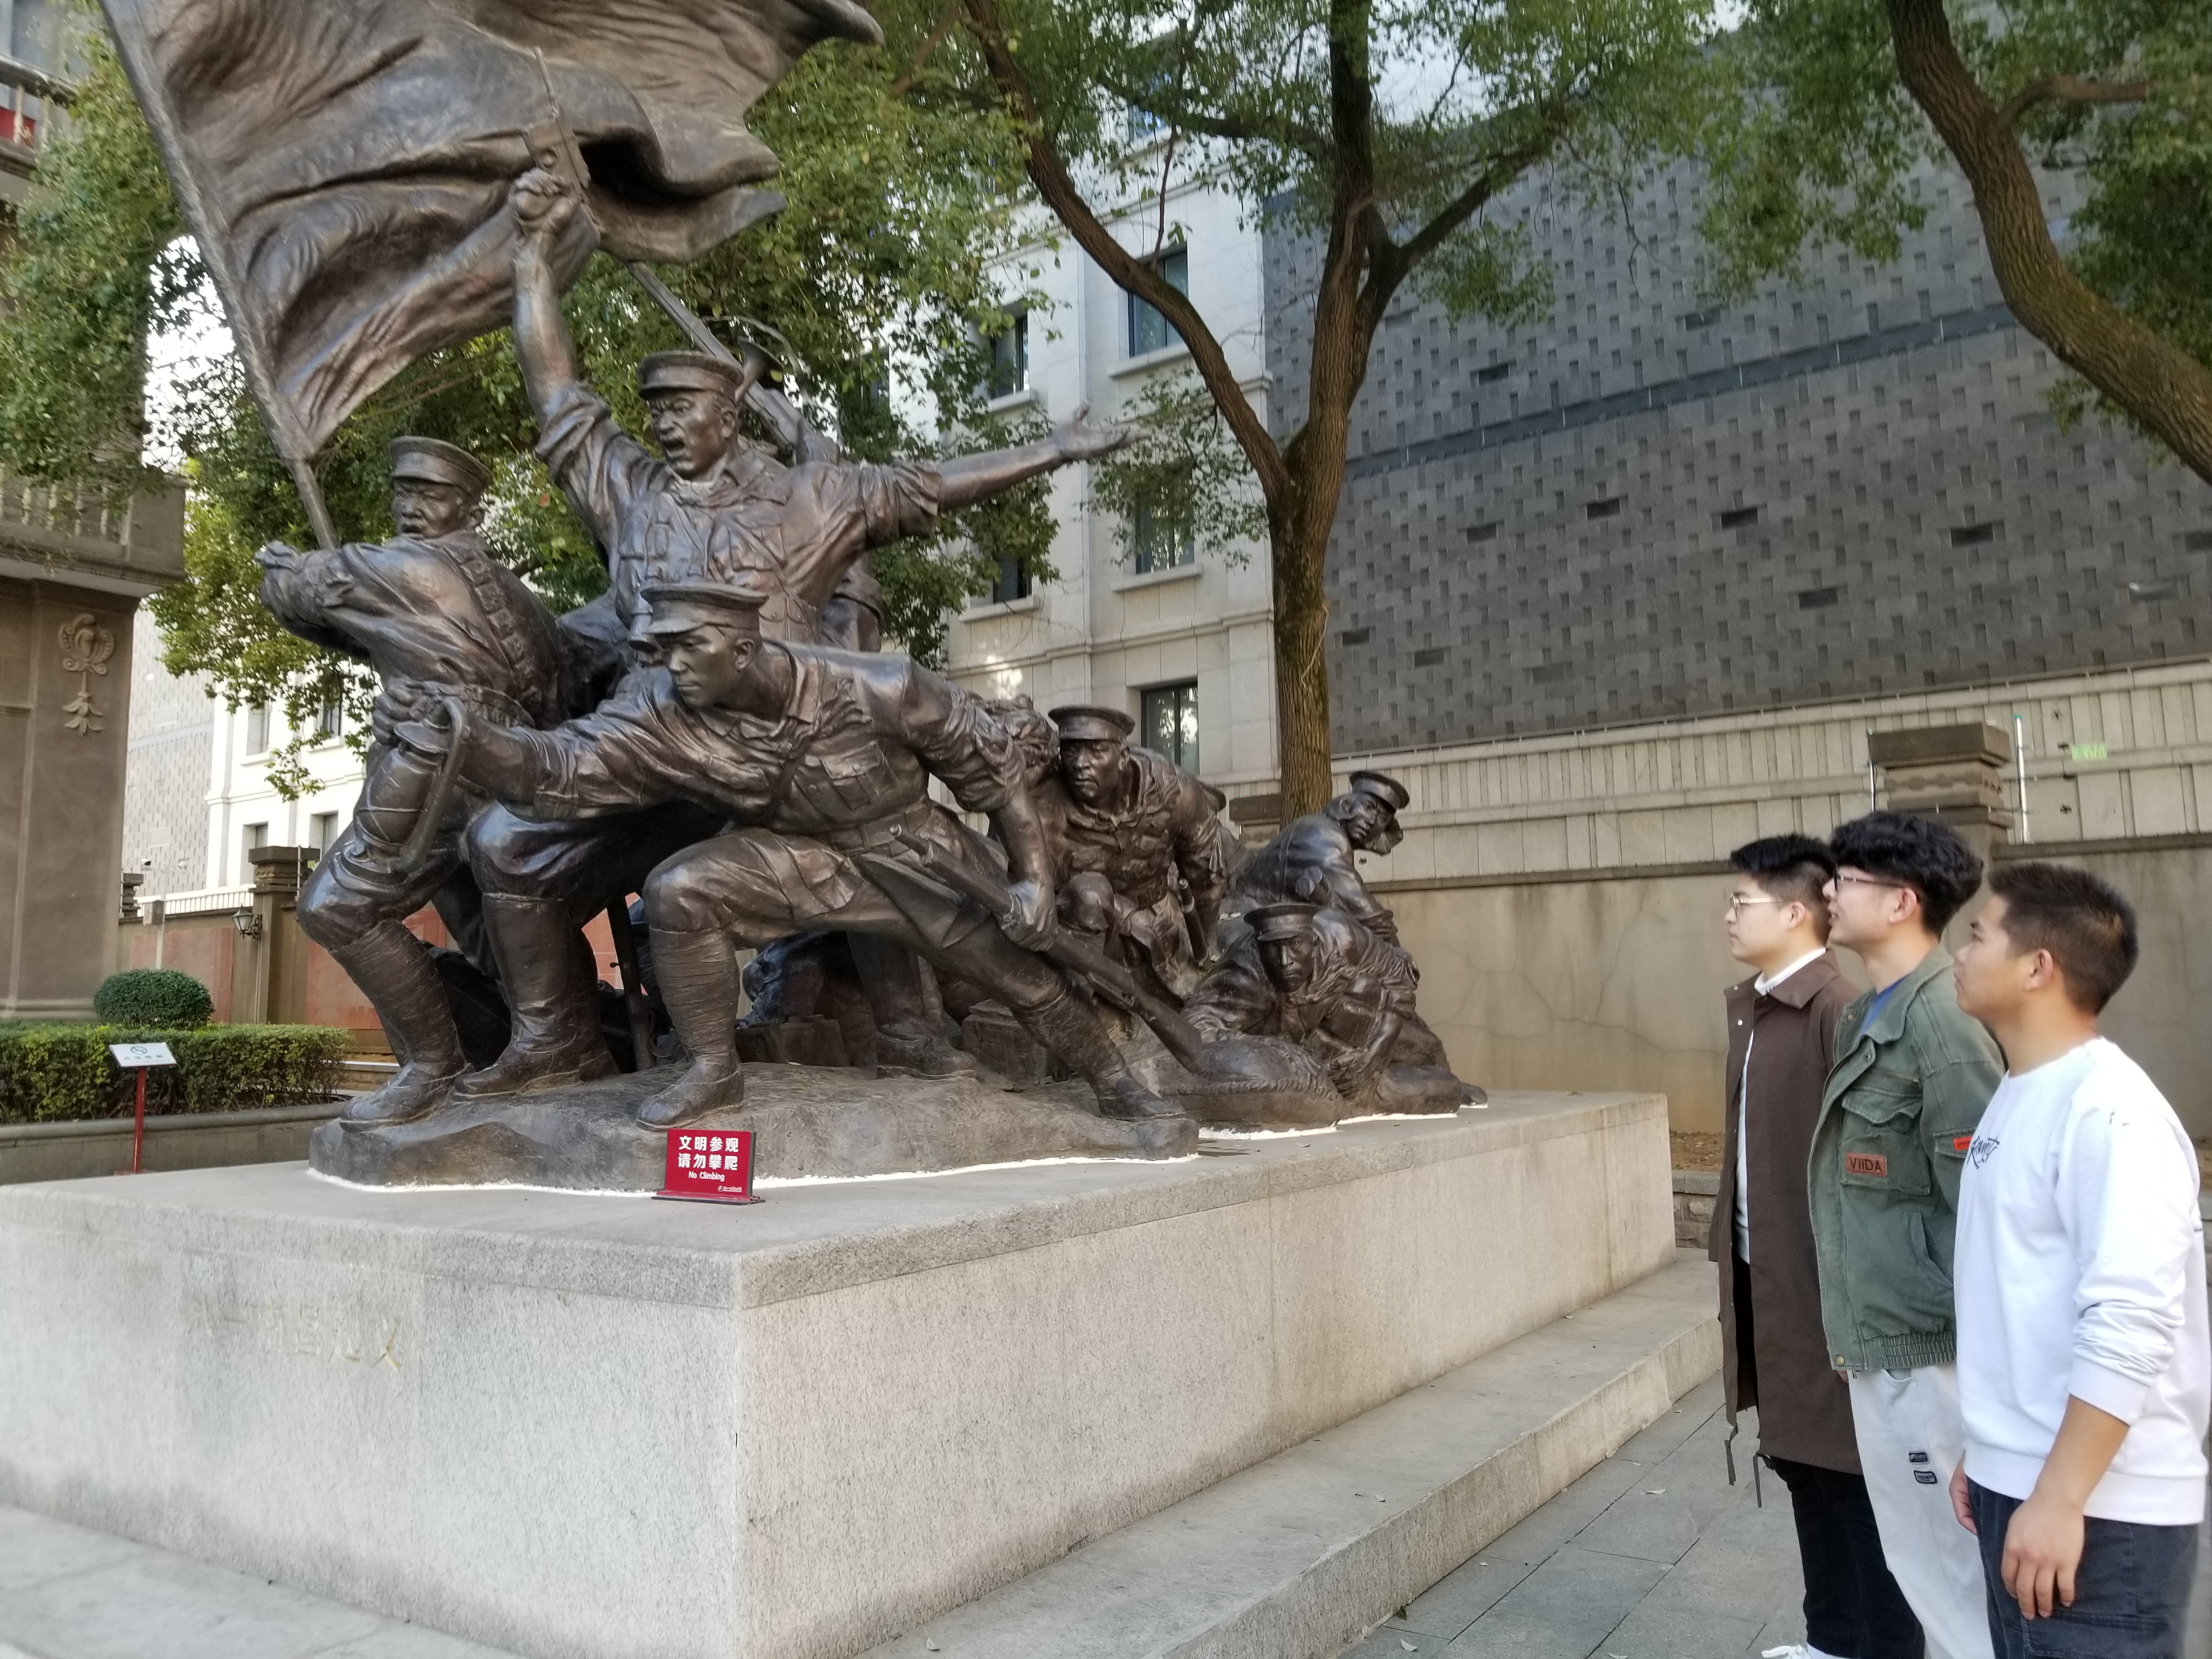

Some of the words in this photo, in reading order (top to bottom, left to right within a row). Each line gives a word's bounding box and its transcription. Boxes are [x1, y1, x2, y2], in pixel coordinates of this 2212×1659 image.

[679, 1135, 738, 1152] 文明参观
[678, 1153, 738, 1170] 请勿攀爬
[699, 1172, 725, 1182] Climbing
